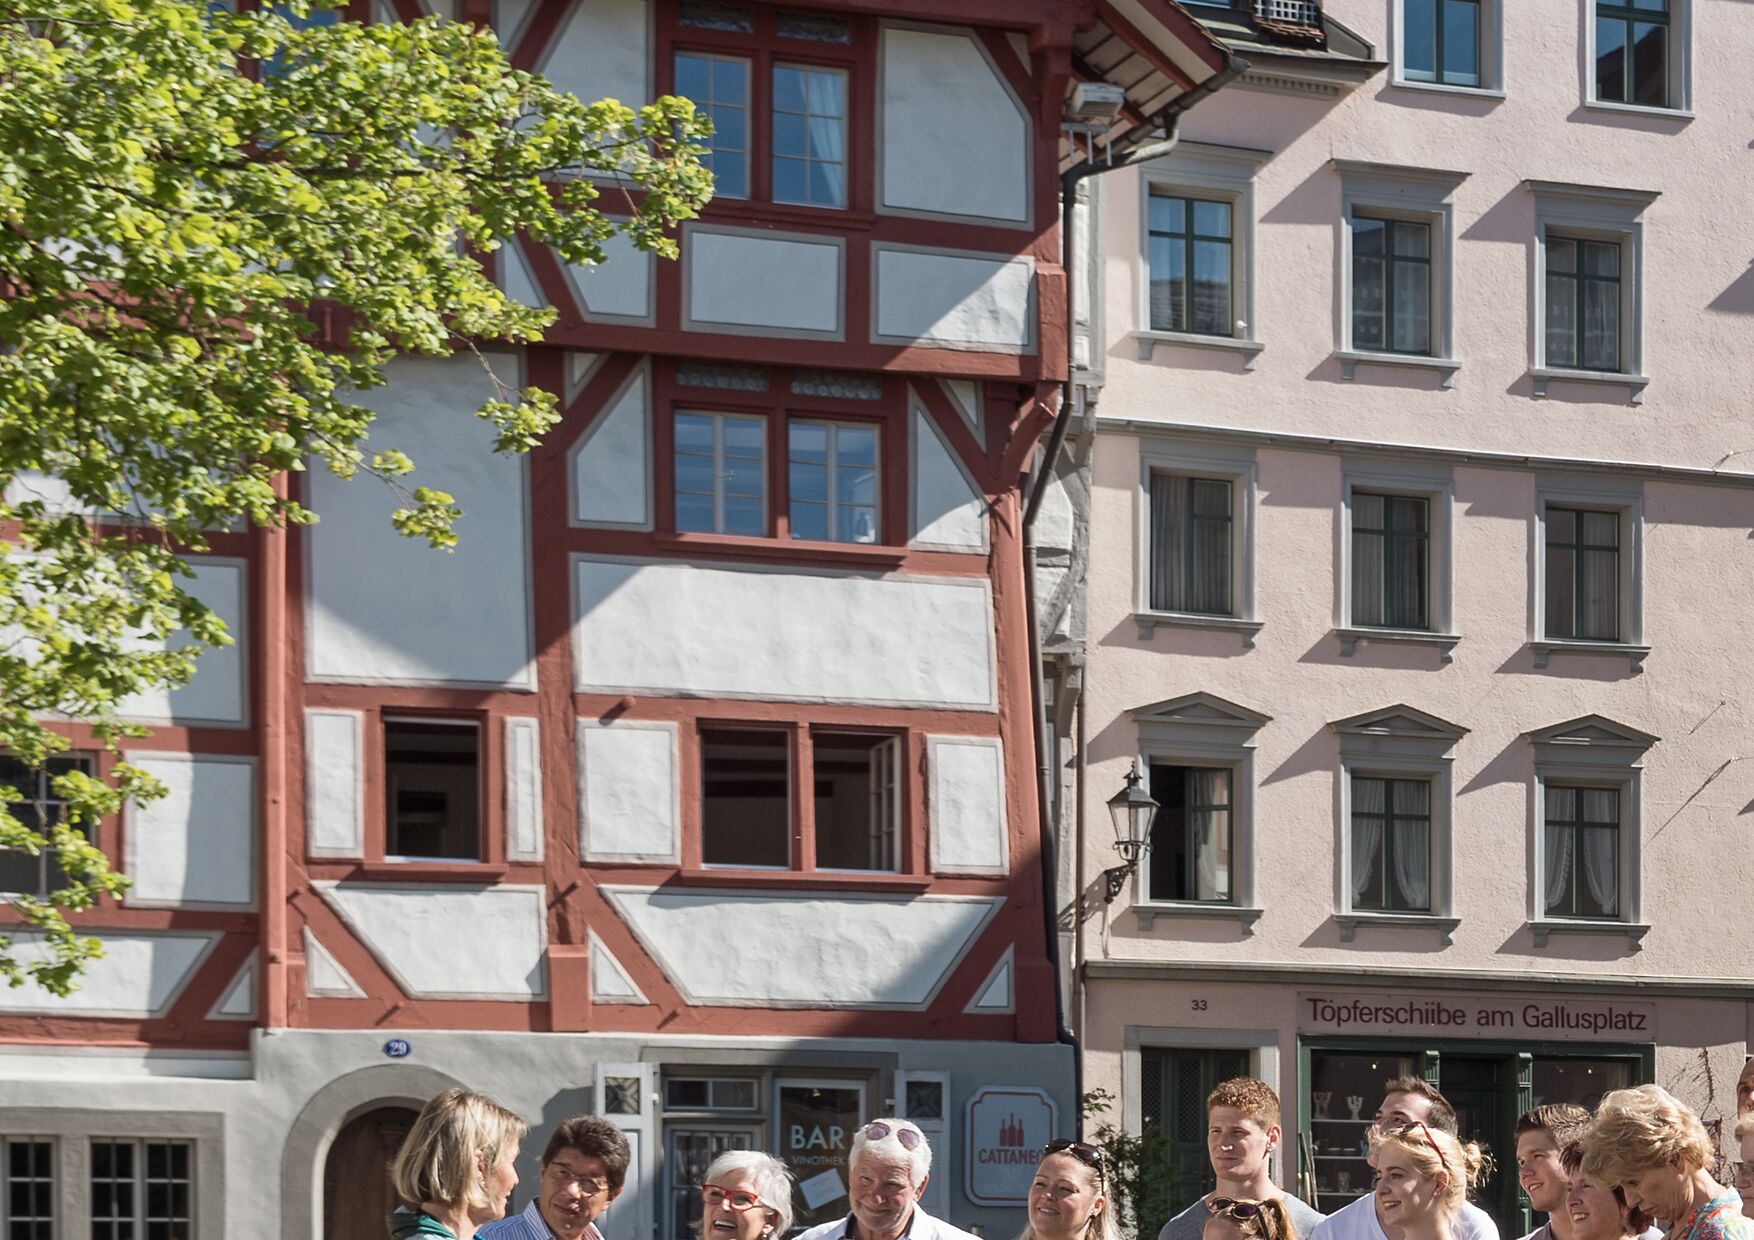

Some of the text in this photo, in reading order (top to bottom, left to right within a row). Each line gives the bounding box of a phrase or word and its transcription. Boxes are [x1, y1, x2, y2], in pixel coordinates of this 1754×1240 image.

[1191, 999, 1208, 1012] 33
[1306, 998, 1648, 1035] Töpferschiibe am Gallusplatz
[390, 1041, 408, 1056] 29
[790, 1124, 846, 1150] BAR
[792, 1154, 847, 1167] VINOTHEK
